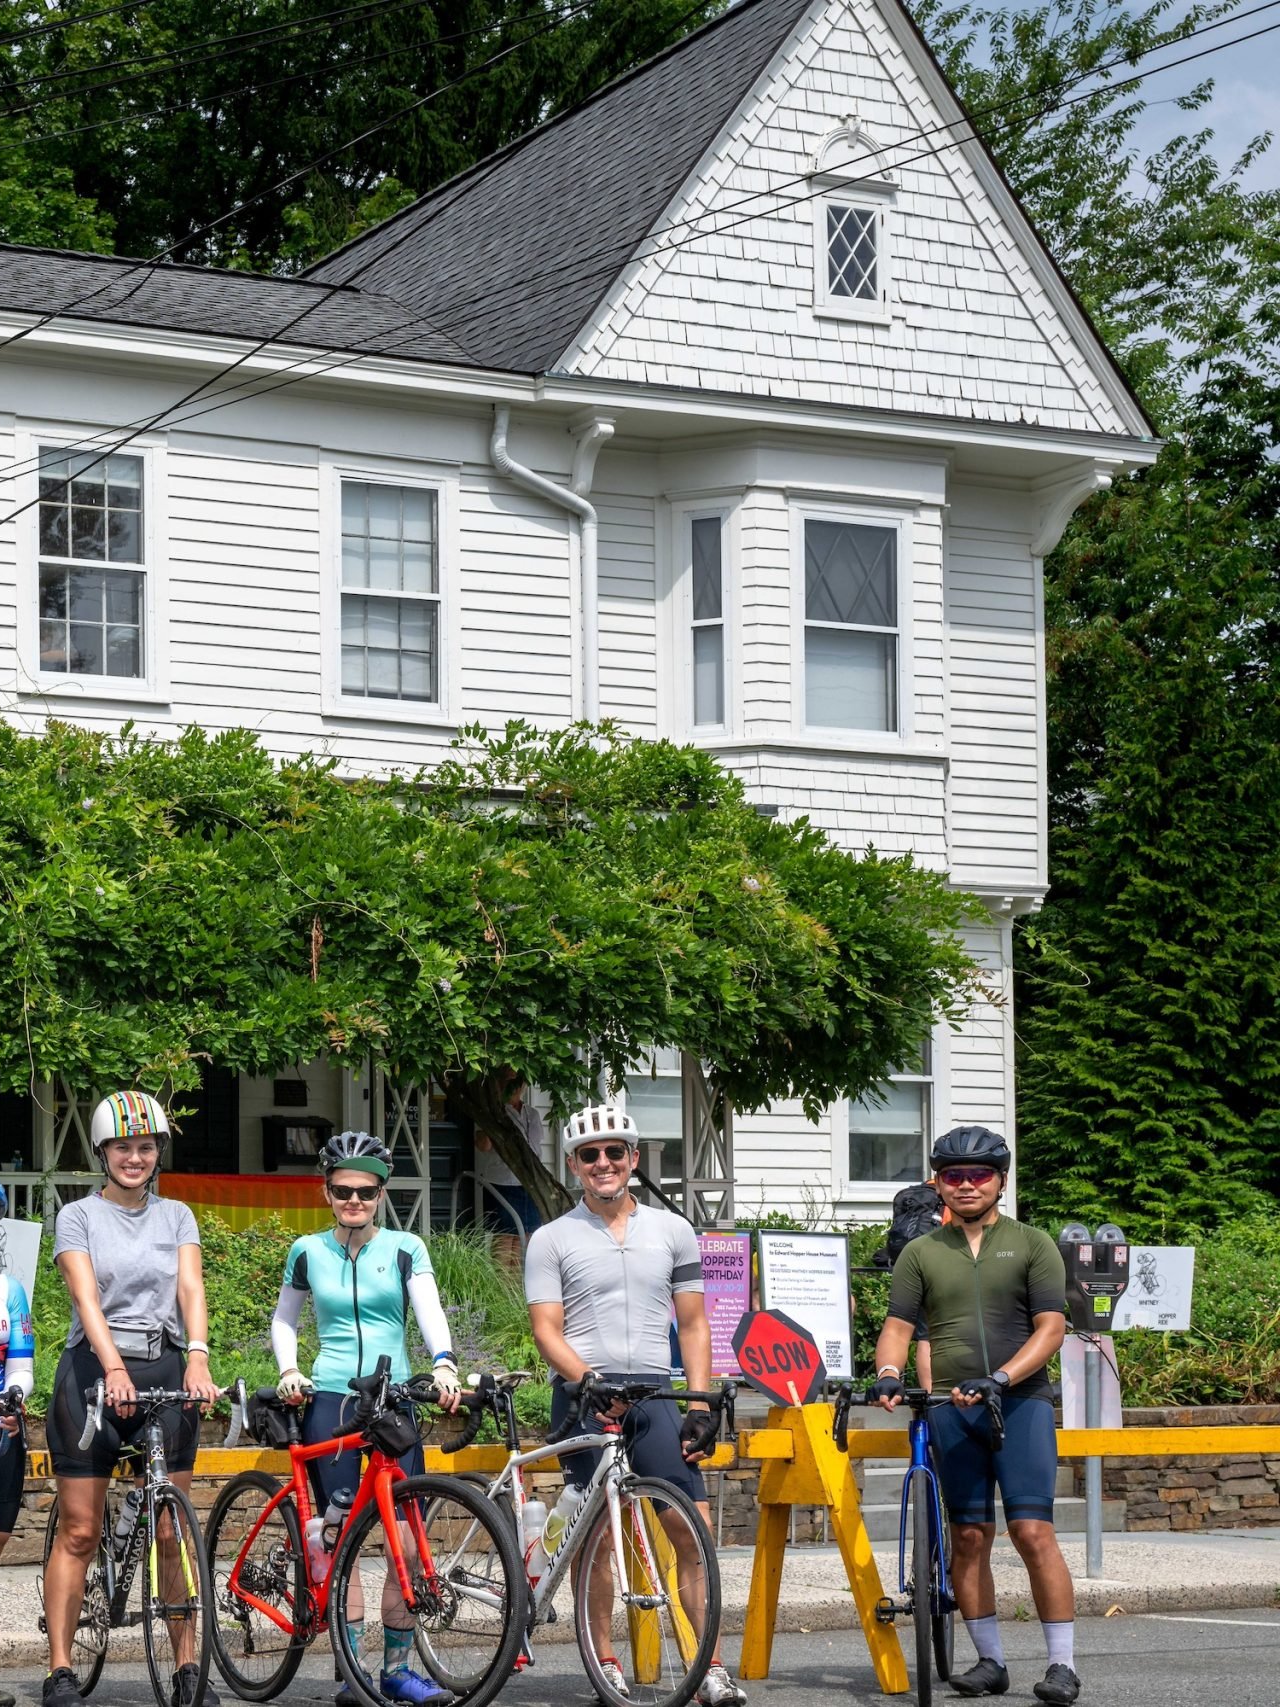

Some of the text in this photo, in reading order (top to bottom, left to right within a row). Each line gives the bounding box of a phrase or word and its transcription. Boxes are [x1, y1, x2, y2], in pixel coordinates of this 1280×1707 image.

[996, 1250, 1015, 1258] GORE
[706, 1283, 721, 1292] JULY
[744, 1340, 811, 1376] SLOW
[121, 1528, 146, 1592] COLNAGO
